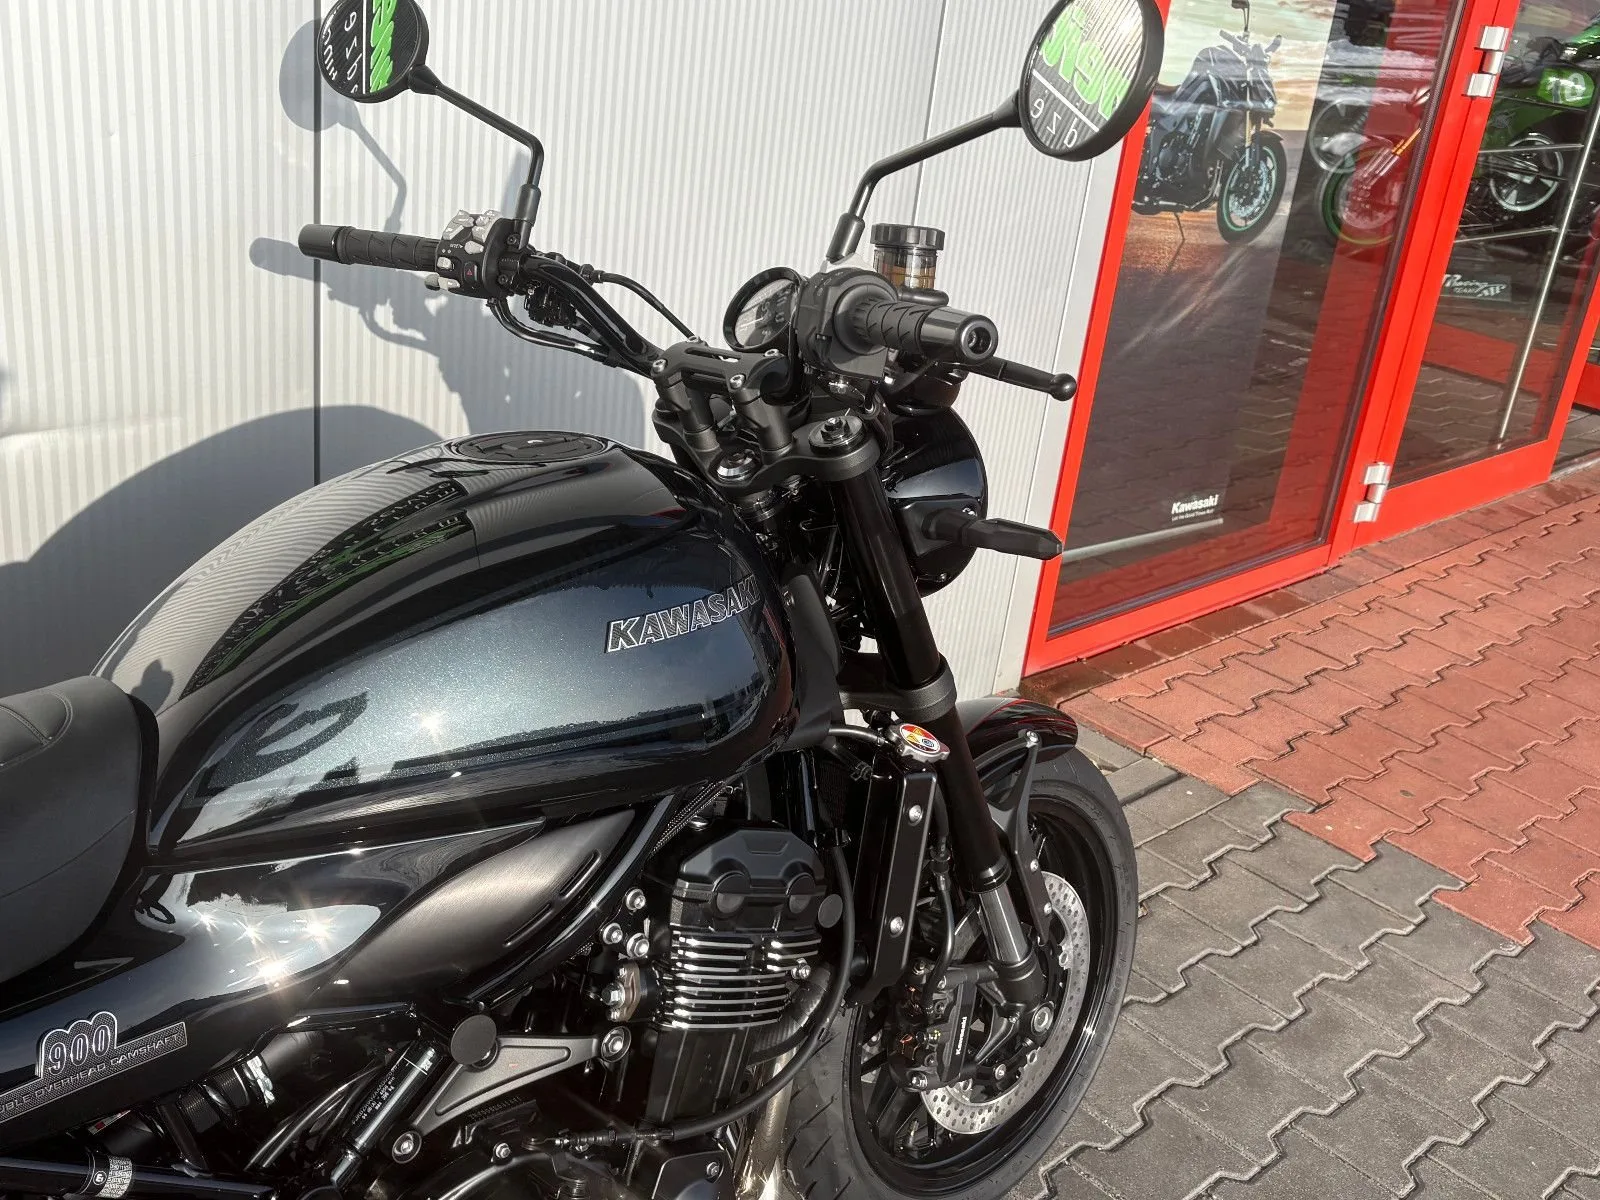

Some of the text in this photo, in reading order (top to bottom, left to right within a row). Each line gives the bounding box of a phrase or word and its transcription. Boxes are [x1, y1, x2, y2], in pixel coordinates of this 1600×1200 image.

[1171, 494, 1219, 515] Kawasaki
[606, 574, 760, 653] KAWASAKI
[48, 1024, 111, 1076] 900
[955, 1016, 968, 1056] Kawasaki
[34, 1062, 107, 1097] OVERHEAD
[109, 1033, 180, 1067] CAMSHAFT
